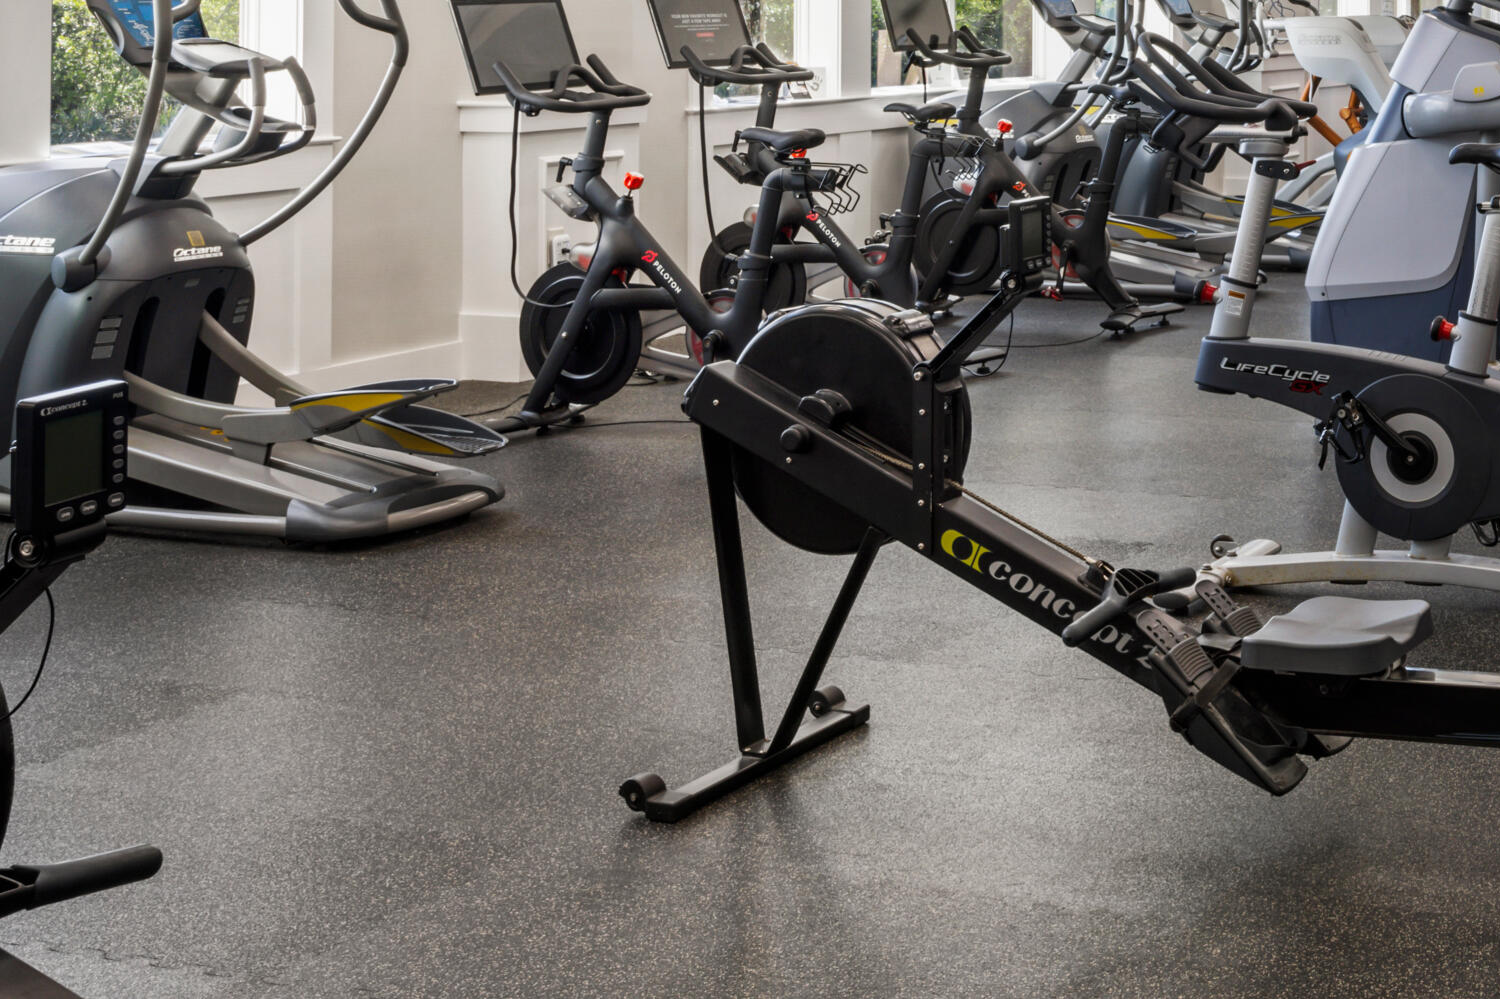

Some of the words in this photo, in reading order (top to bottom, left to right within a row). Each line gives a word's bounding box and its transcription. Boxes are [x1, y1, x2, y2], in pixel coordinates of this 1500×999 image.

[815, 218, 841, 248] PELOTON
[173, 246, 222, 257] Octane
[652, 260, 682, 294] PELOTON
[1289, 379, 1328, 396] GX
[51, 401, 81, 413] concept
